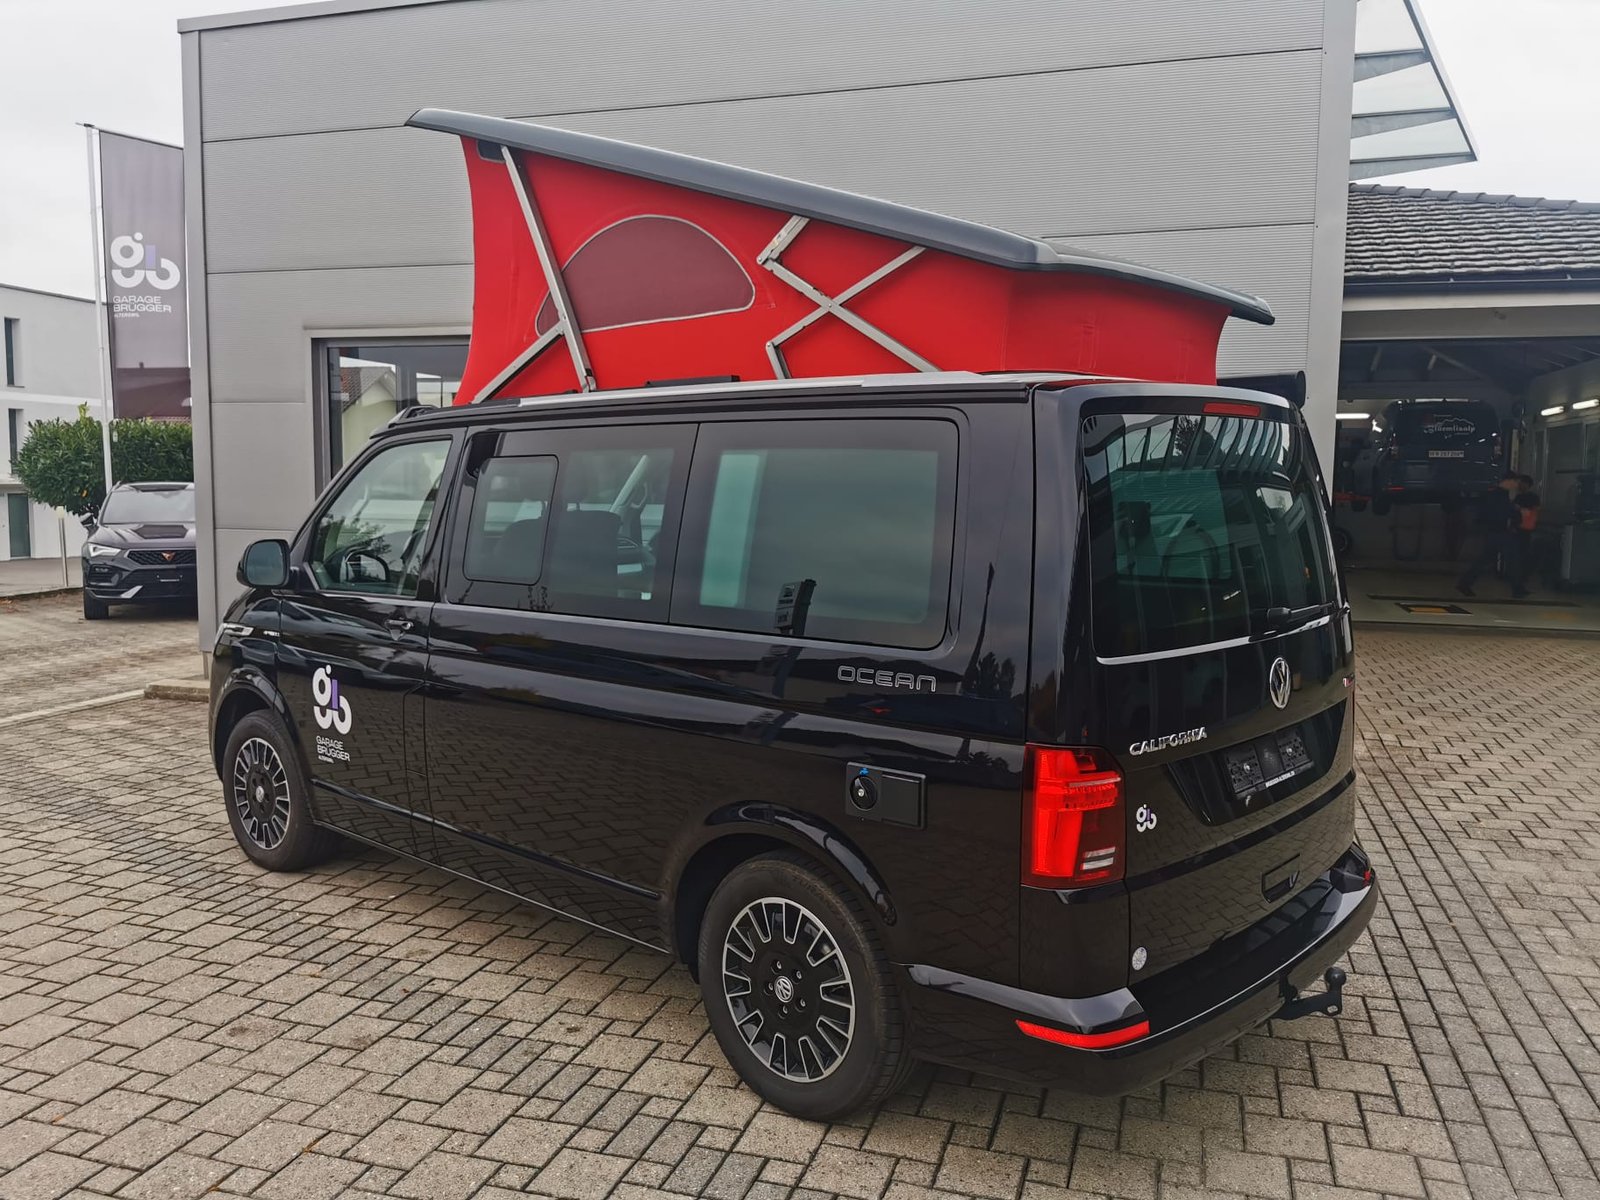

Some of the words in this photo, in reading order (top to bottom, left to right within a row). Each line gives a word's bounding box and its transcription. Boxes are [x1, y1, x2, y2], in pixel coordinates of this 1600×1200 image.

[113, 295, 162, 304] GARAGE
[113, 302, 172, 313] BRÜGGER
[837, 665, 937, 693] OCEAN
[315, 735, 344, 751] GARAGE
[1129, 727, 1208, 756] CALIFORNIA
